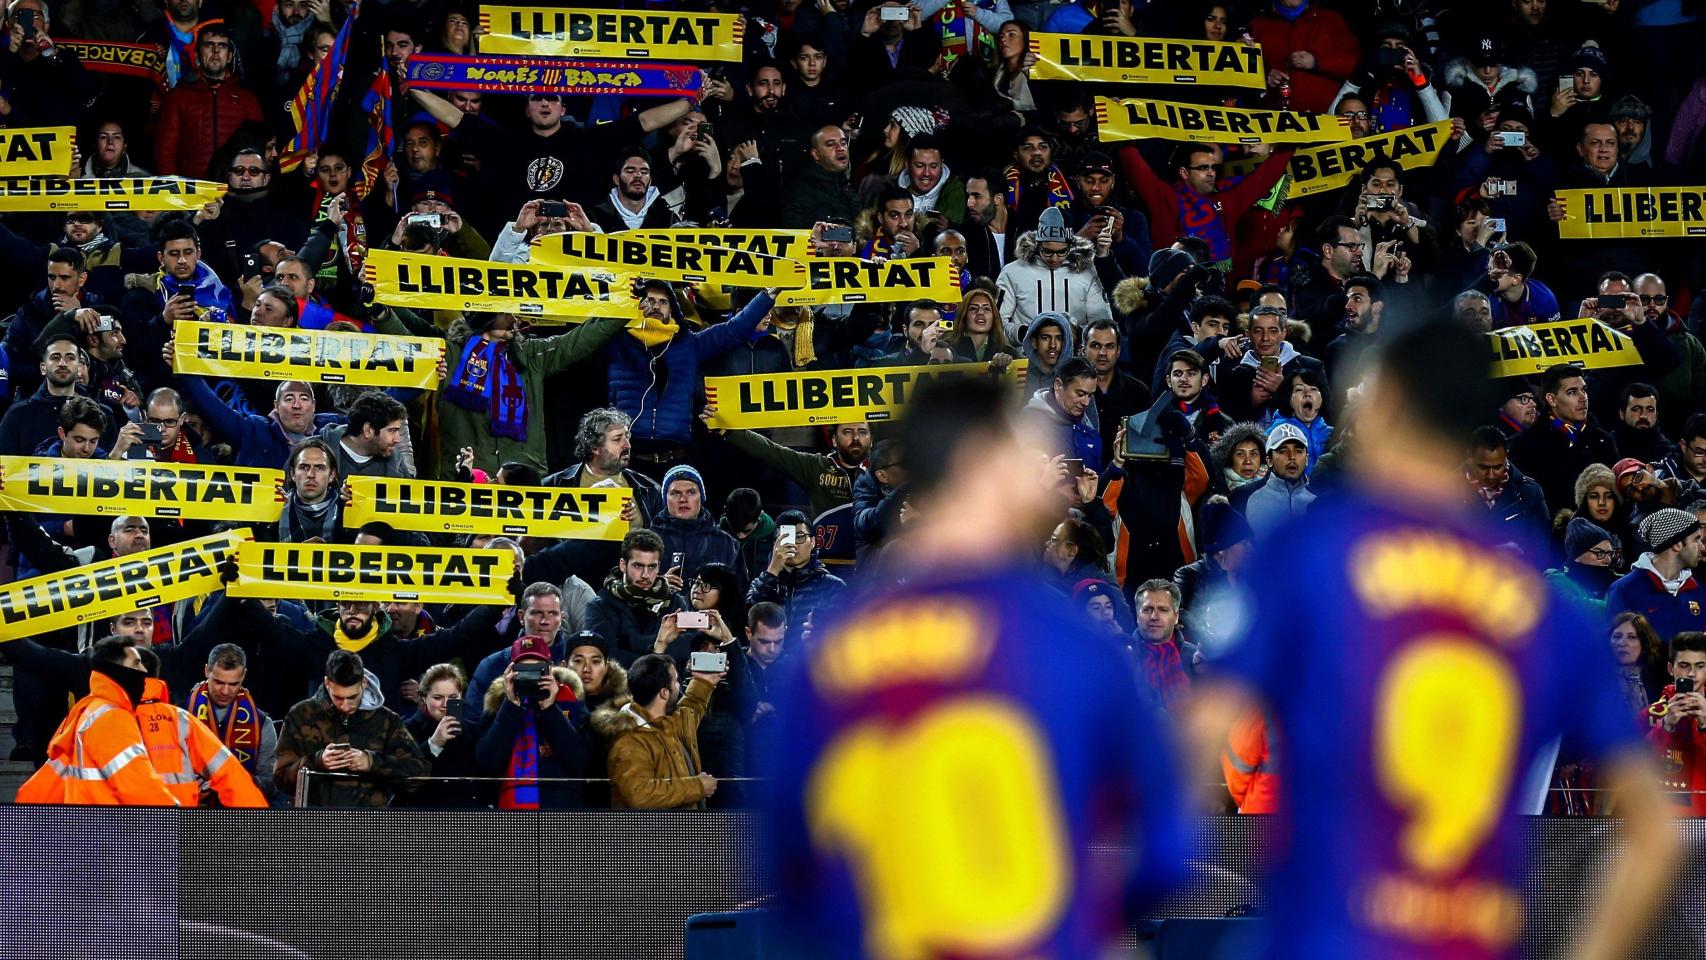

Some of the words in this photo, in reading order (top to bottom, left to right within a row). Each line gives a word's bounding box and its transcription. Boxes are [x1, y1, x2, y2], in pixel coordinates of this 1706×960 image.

[511, 11, 720, 46] LLIBERTAT
[1059, 38, 1262, 74] LLIBERTAT
[1126, 99, 1322, 133] LLIBERTAT
[1584, 192, 1706, 222] LLIBER
[562, 234, 775, 276] LLIBERTAT
[398, 264, 615, 301] LLIBERTAT
[809, 261, 935, 290] ERTAT
[198, 328, 422, 373] LLIBERTAT
[1494, 323, 1623, 361] LIBERTAT
[740, 370, 962, 413] LLIBERT
[1280, 424, 1296, 437] NY
[28, 463, 260, 504] LLIBERTAT
[375, 483, 607, 523] LLIBERTAT
[0, 539, 230, 624] LLIBERTAT
[262, 549, 498, 587] LLIBERTAT
[1372, 632, 1522, 878] 9
